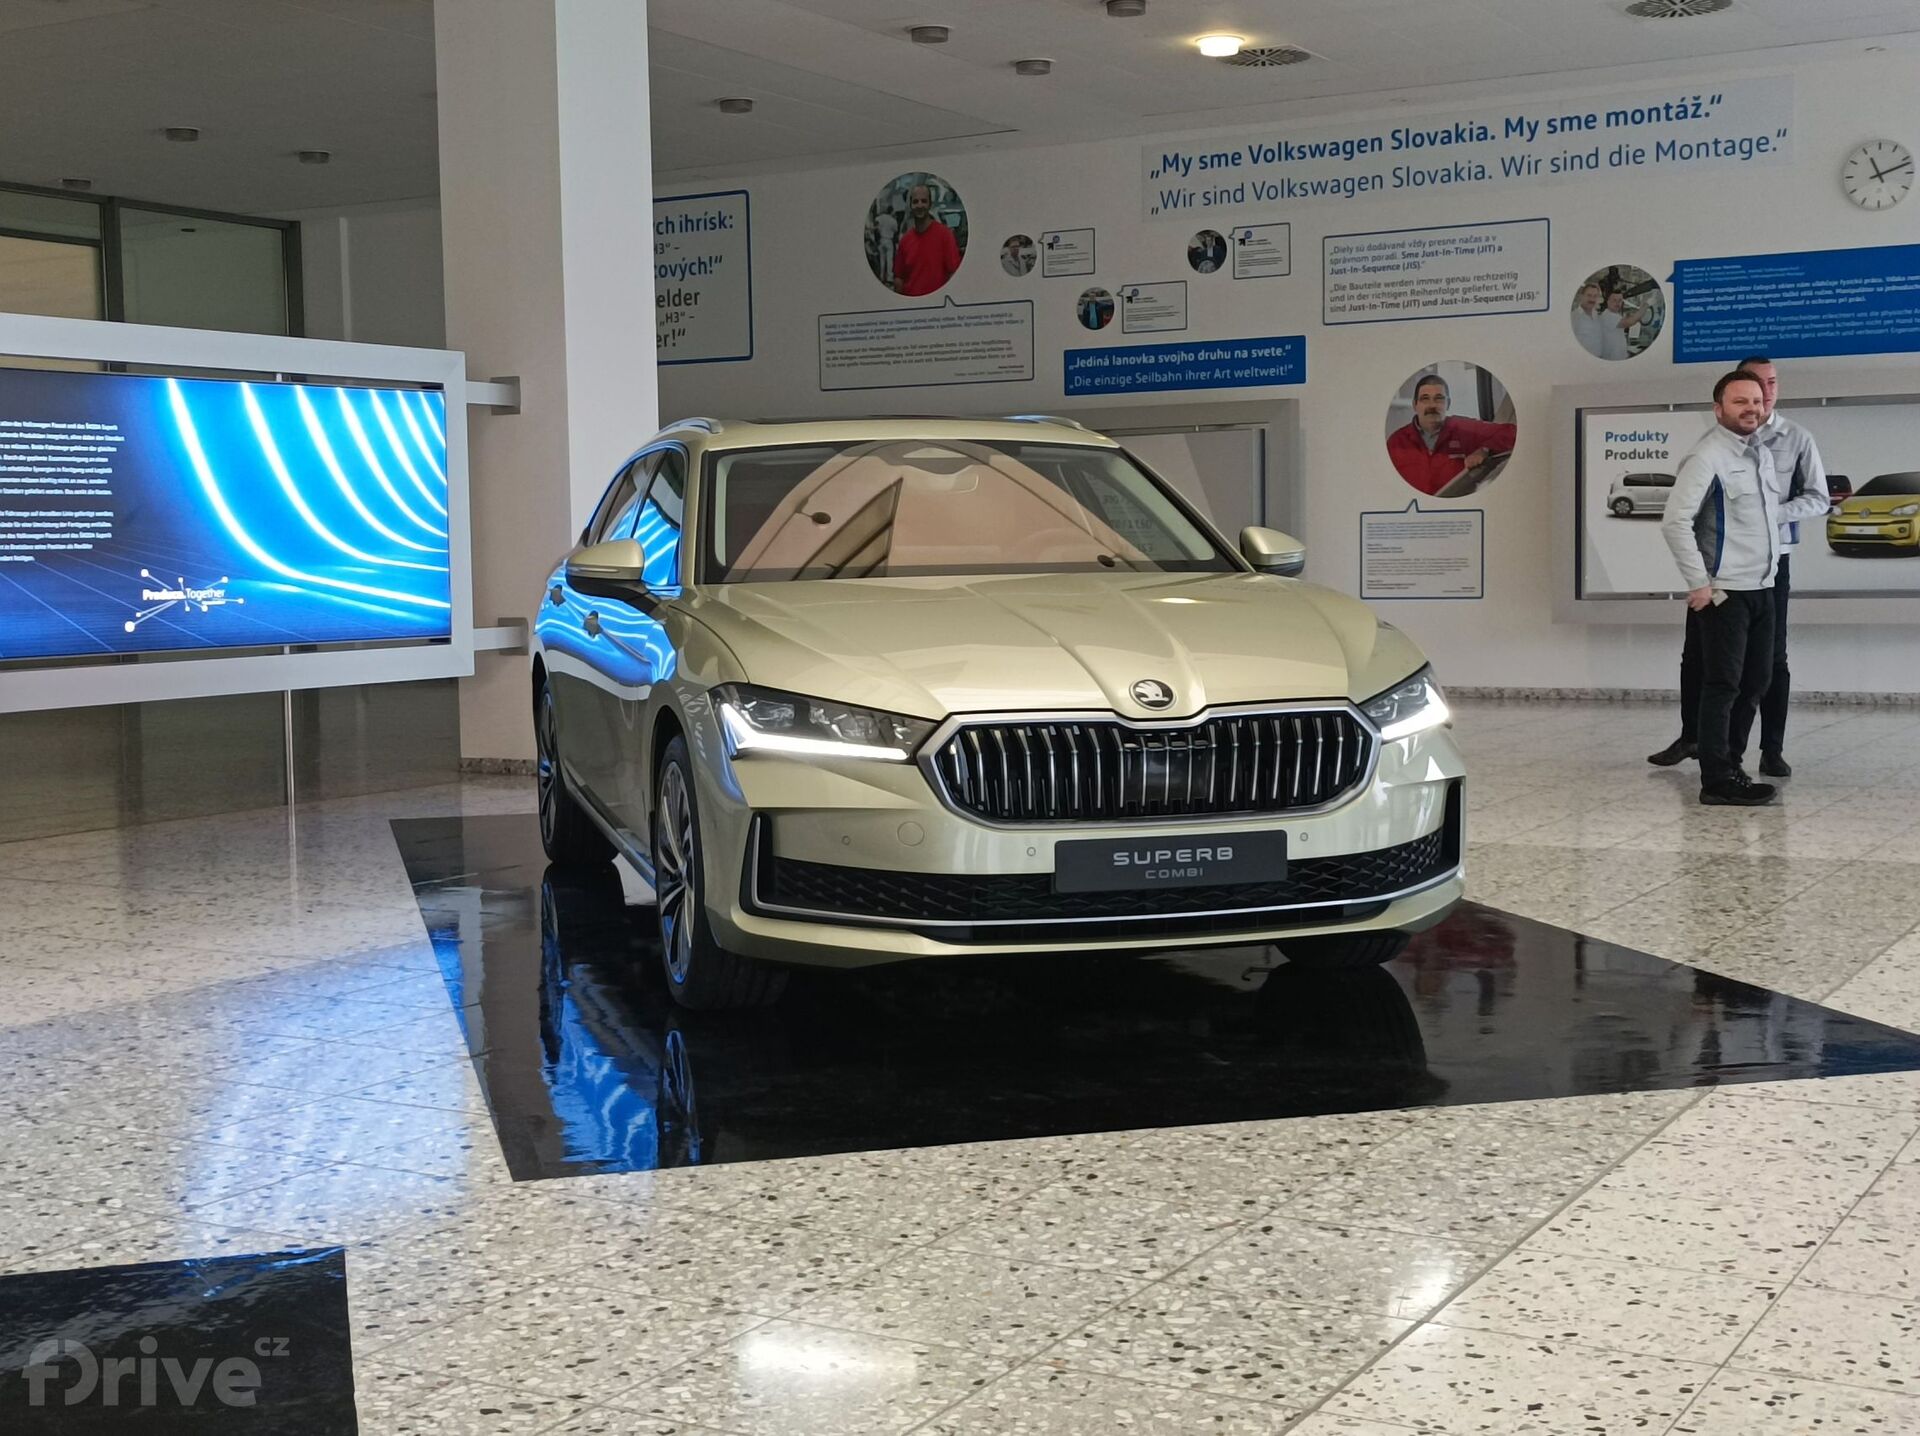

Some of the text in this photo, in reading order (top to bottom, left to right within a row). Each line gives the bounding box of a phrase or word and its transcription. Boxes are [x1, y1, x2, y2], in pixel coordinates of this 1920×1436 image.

[1150, 95, 1722, 178] „My sme Volkswagen Slovakia. My sme montáž.“
[1151, 129, 1786, 215] „Wir sind Volkswagen Slovakia. Wir sind die Montage.“
[653, 210, 734, 235] ch ihrísk:
[653, 255, 723, 281] ových!“
[1112, 353, 1155, 365] lanovka
[1158, 351, 1194, 364] svojho
[1197, 348, 1231, 360] druhu
[1234, 350, 1248, 358] na
[1094, 375, 1131, 387] einzige
[1136, 371, 1181, 383] Seilbahn
[1186, 370, 1210, 380] ihrer
[1214, 368, 1230, 379] Art
[1605, 430, 1669, 444] Produkty
[1604, 448, 1669, 460] Produkte
[1113, 847, 1233, 865] SUPERB
[1144, 868, 1203, 879] COMBI
